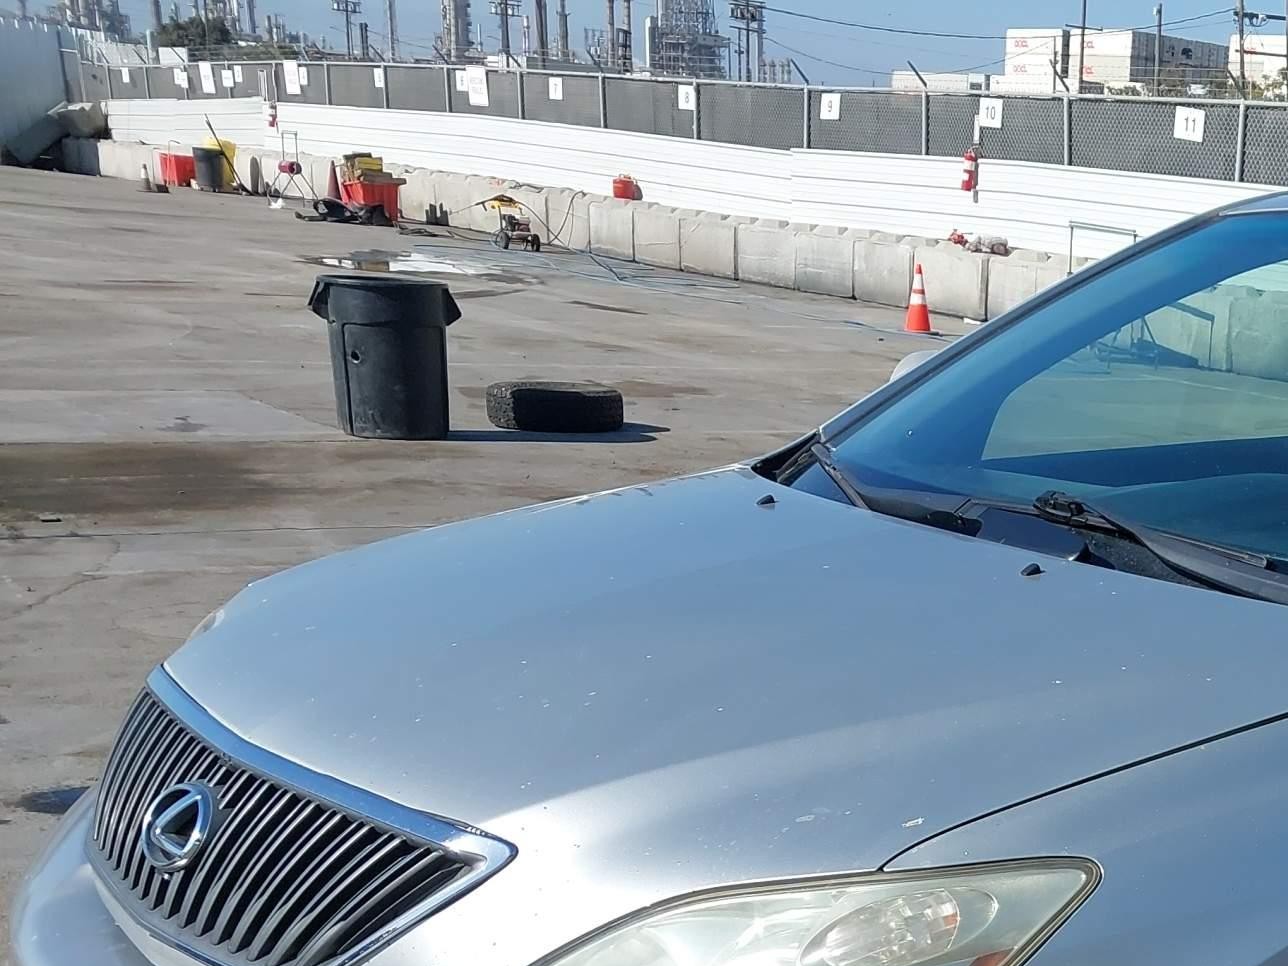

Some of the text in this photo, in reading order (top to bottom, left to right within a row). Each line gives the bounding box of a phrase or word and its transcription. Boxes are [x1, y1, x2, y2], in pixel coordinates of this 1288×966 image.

[827, 99, 833, 113] 9
[985, 105, 996, 120] 10
[1184, 116, 1196, 133] 11
